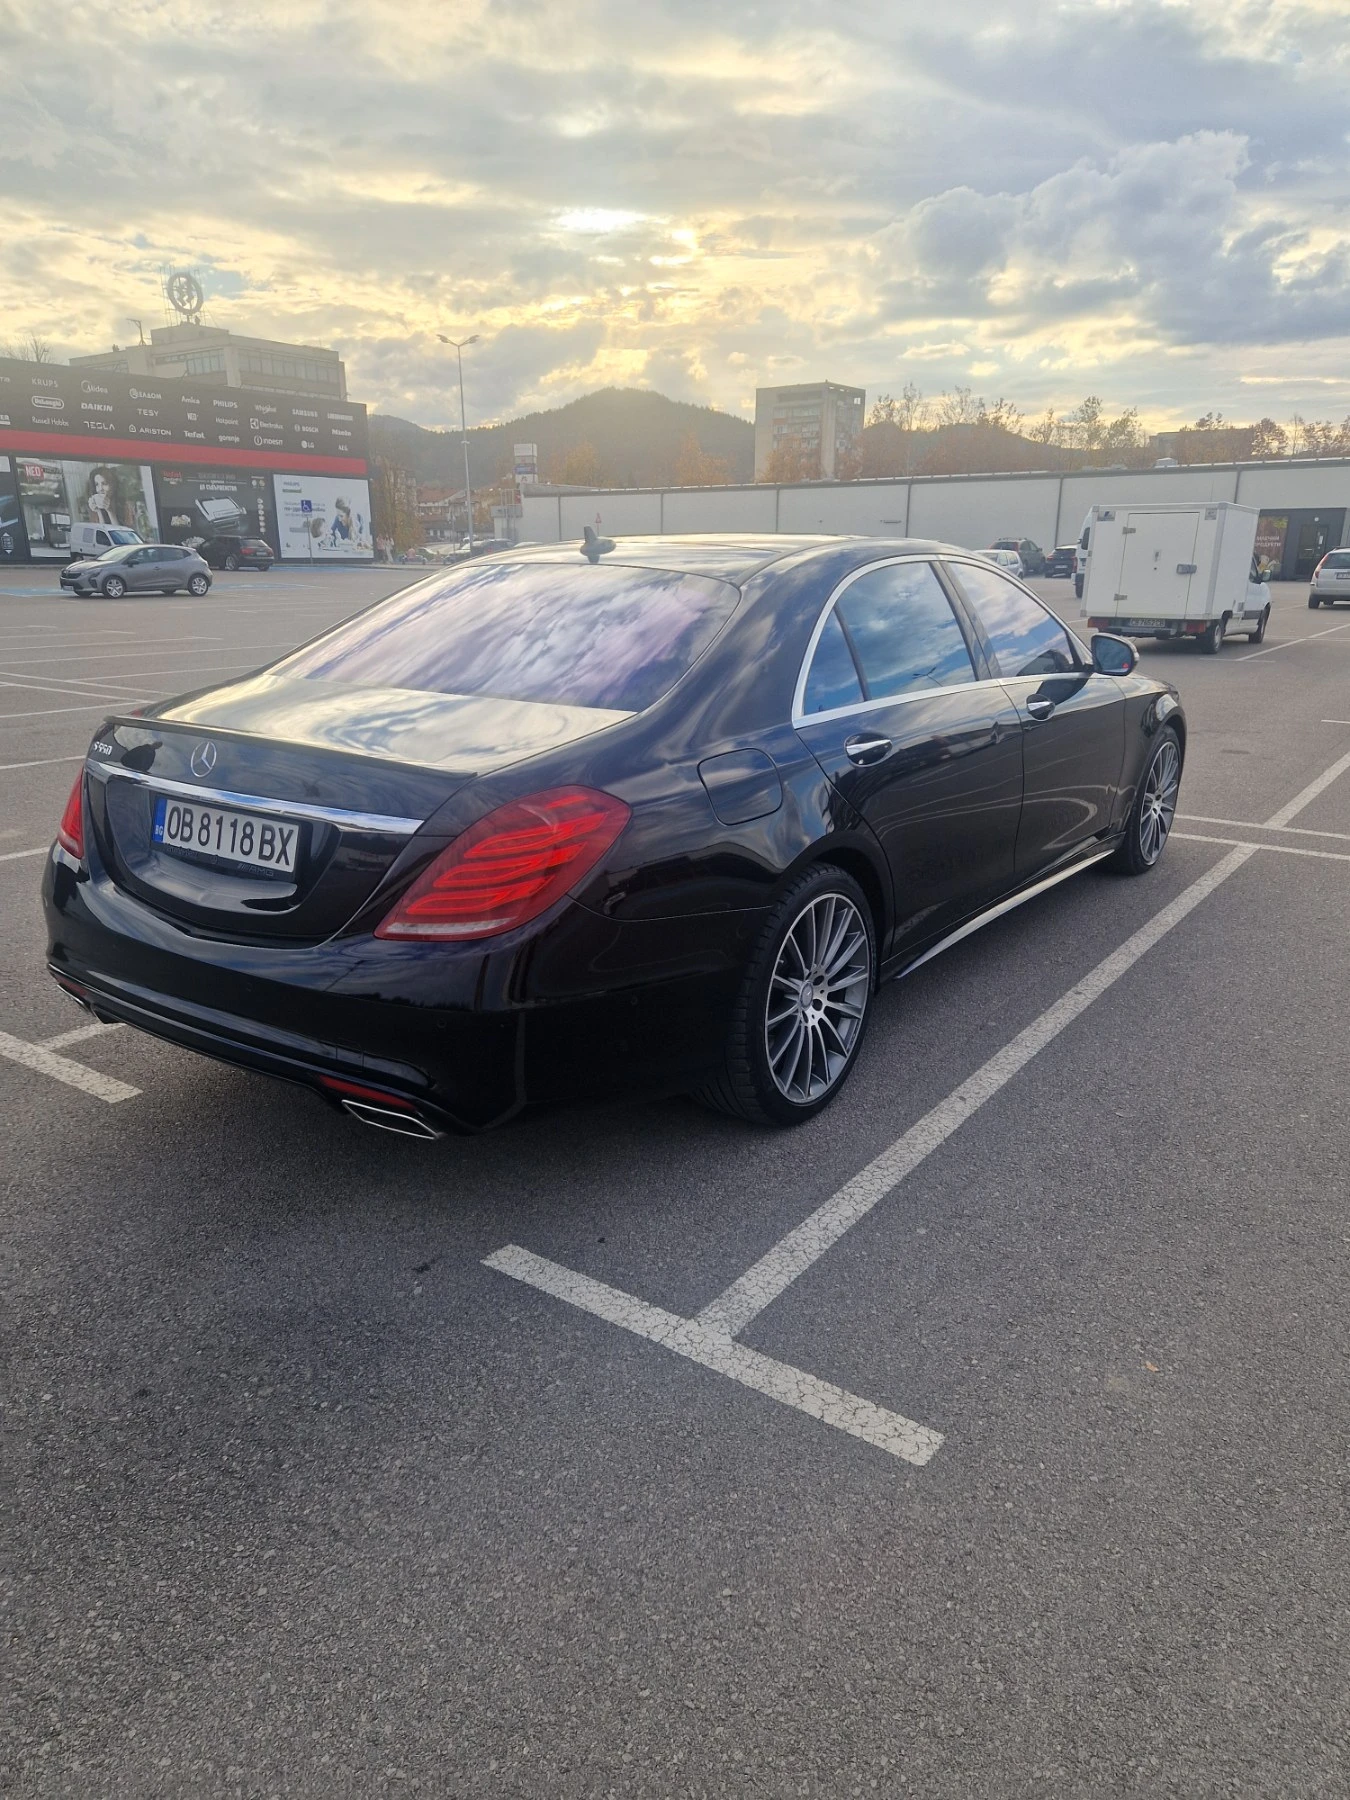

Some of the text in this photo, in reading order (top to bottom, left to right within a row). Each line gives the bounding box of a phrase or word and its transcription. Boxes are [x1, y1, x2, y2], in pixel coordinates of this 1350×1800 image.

[31, 377, 58, 388] KRUPS
[84, 381, 108, 393] Midea
[181, 396, 200, 404] Amica
[213, 400, 238, 409] PHILIPS
[81, 403, 113, 412] DAIKIN
[137, 408, 159, 417] TESY
[292, 409, 318, 417] SAMSUNG
[83, 421, 116, 430] TESLA
[301, 425, 319, 433] BOSCH
[139, 427, 172, 436] ARISTON
[218, 434, 240, 443] gorenje
[155, 825, 163, 836] BG
